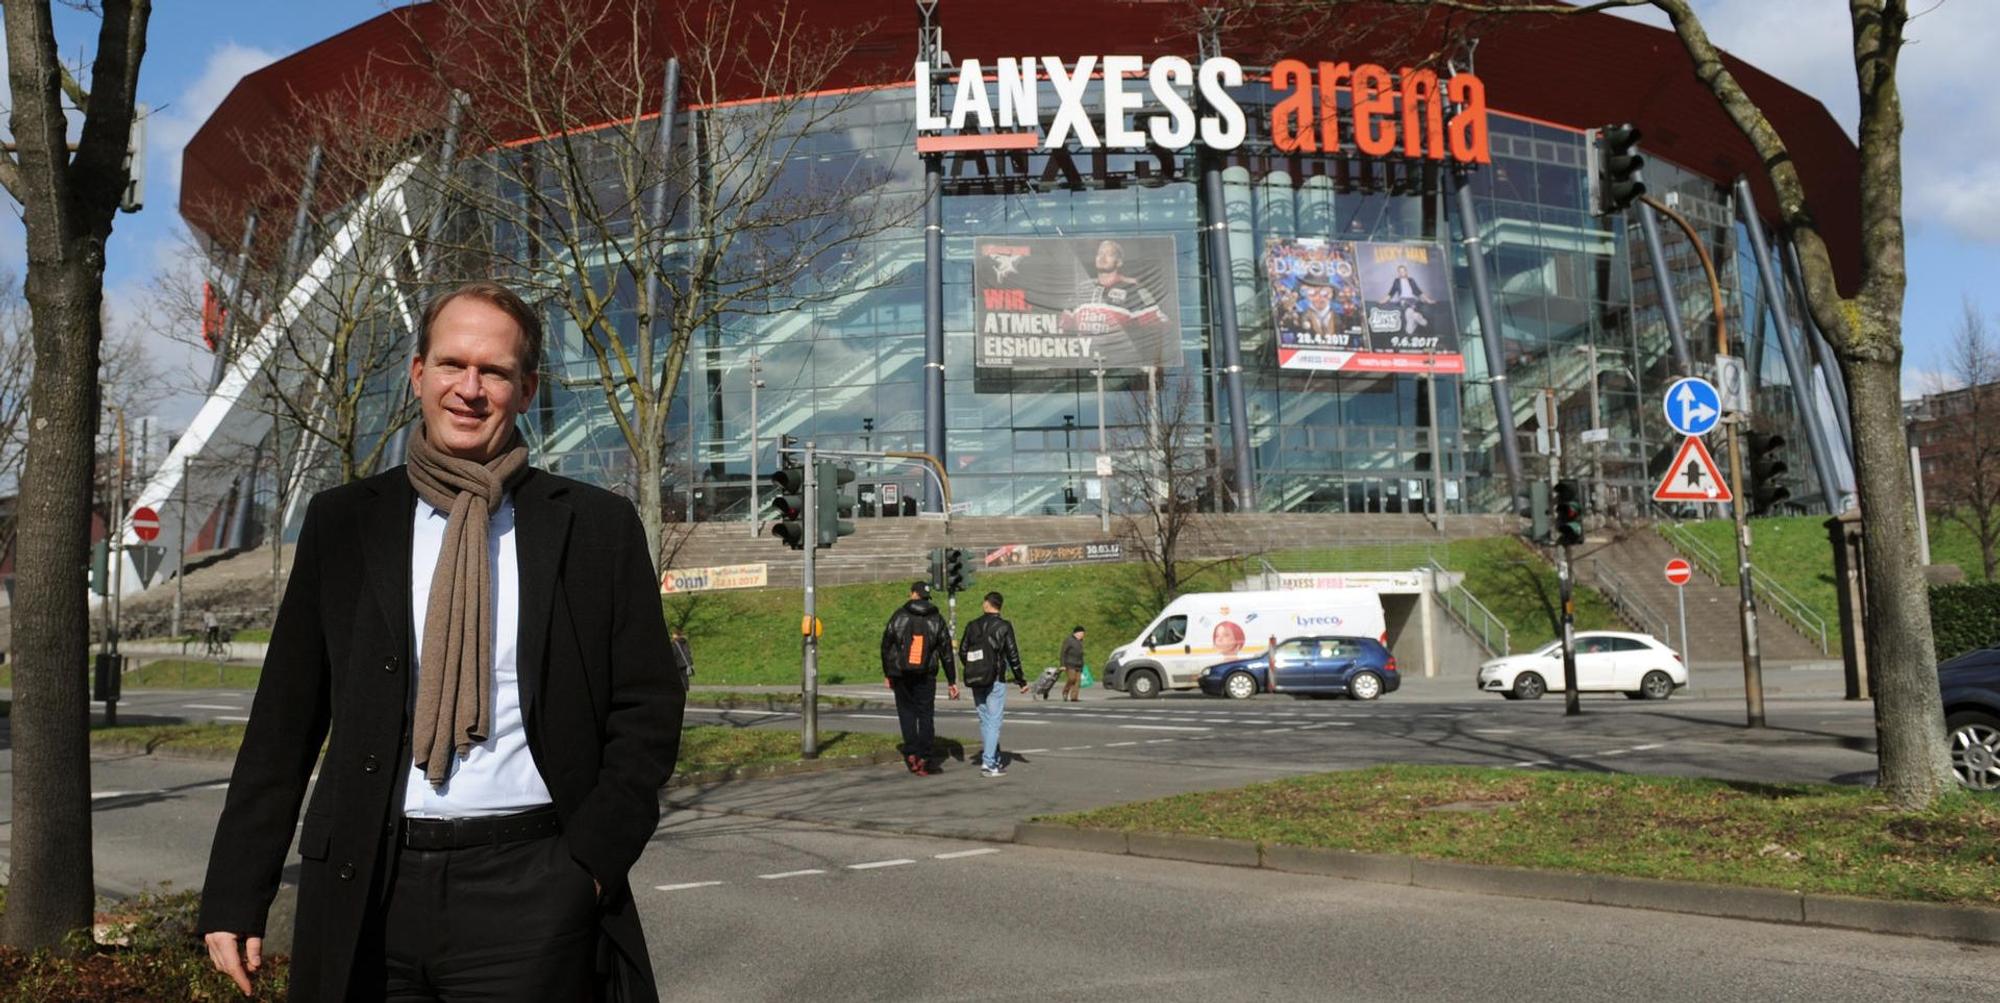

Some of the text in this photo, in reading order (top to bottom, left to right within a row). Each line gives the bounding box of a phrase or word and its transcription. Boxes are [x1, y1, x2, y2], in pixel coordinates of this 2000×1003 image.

[916, 54, 1490, 165] LANXESS arena
[983, 288, 1032, 311] WIR.
[984, 312, 1064, 335] ATMEN.
[984, 336, 1100, 358] EISHOCKEY.
[1296, 332, 1350, 347] 28.4.2017
[1390, 336, 1439, 348] 9.6.2017
[664, 569, 708, 592] Conni
